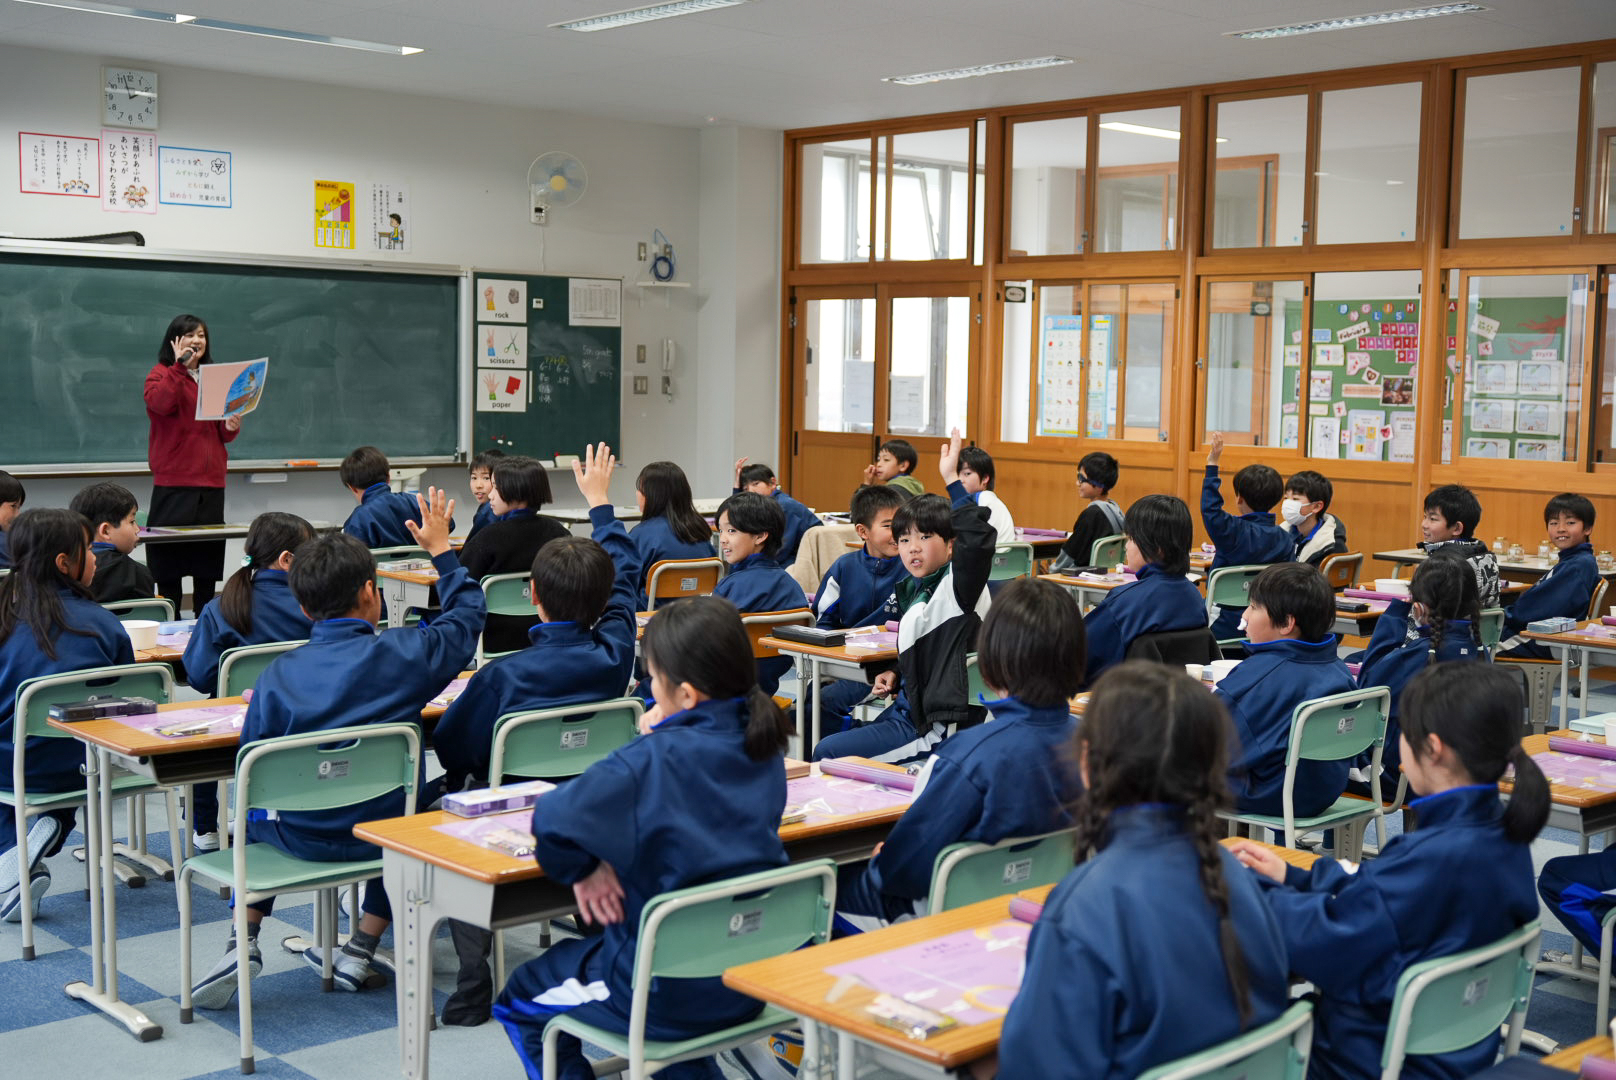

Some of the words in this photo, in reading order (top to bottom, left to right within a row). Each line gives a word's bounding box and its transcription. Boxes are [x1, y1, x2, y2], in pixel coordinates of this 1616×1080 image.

[120, 136, 129, 175] あいさつが
